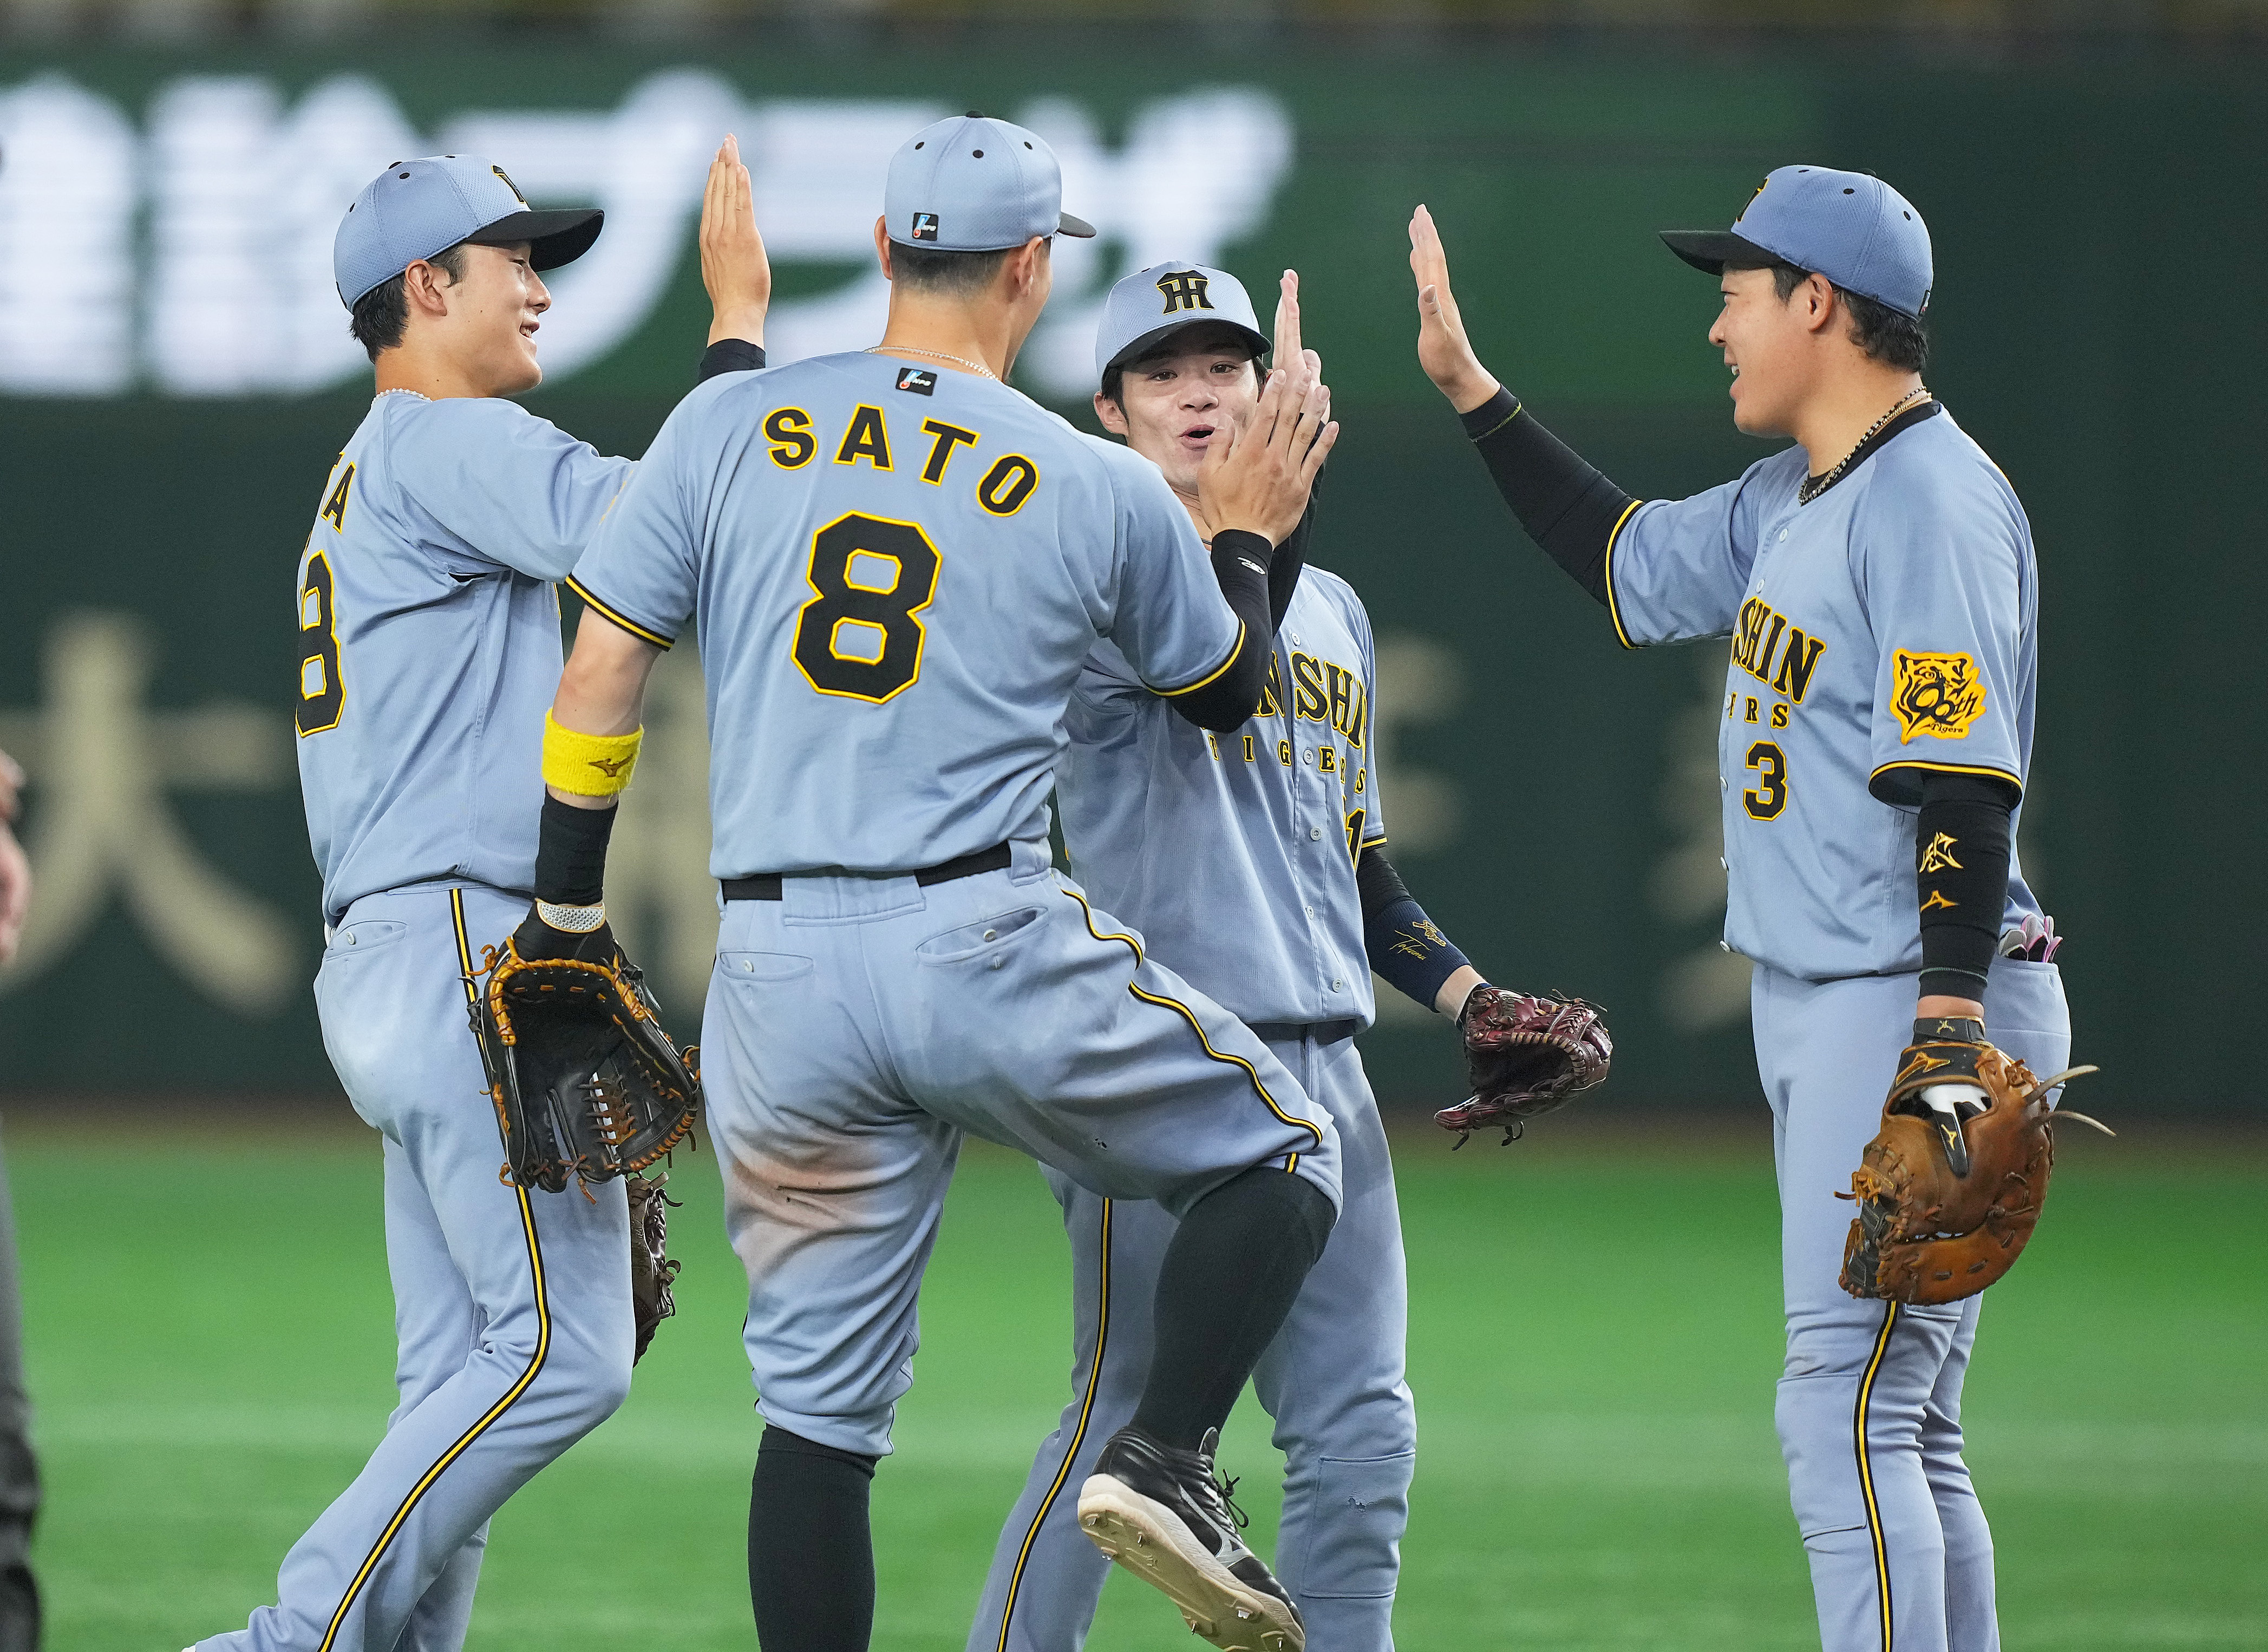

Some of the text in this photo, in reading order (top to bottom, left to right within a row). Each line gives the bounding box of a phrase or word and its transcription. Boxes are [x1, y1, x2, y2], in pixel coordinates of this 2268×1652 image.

[321, 452, 356, 535] A
[762, 403, 1040, 517] SATO
[295, 549, 347, 737] 8
[790, 510, 943, 704] 8
[1731, 596, 1827, 704] SHIN
[1728, 692, 1789, 729] RS
[1743, 740, 1788, 821] 3
[1342, 795, 1367, 870] 1
